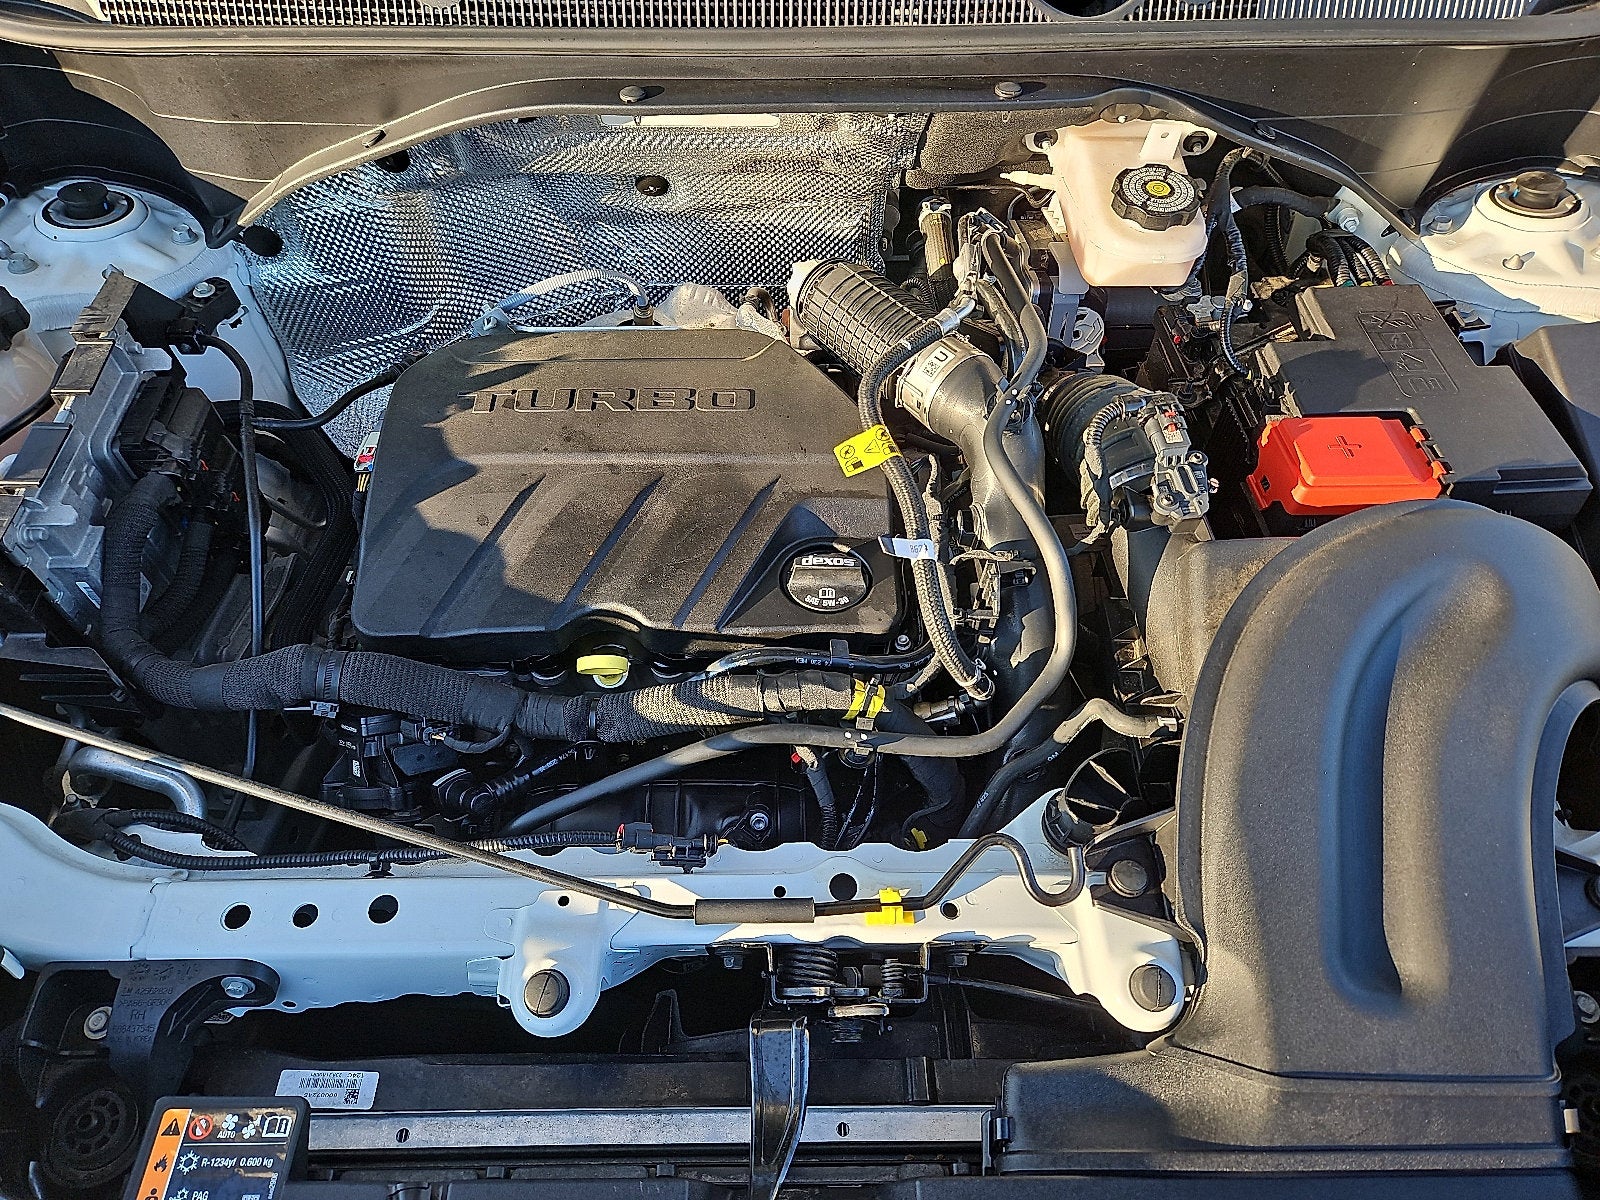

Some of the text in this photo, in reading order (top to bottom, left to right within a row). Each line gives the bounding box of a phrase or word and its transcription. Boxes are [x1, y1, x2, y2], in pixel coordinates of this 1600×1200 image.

[457, 387, 756, 414] TURBO
[801, 554, 857, 567] dexos
[805, 594, 820, 606] SAE
[130, 1010, 146, 1020] RH
[216, 1130, 236, 1139] AUTO
[201, 1157, 273, 1168] R-1234yf 0.600 kg
[191, 1191, 209, 1200] PAG
